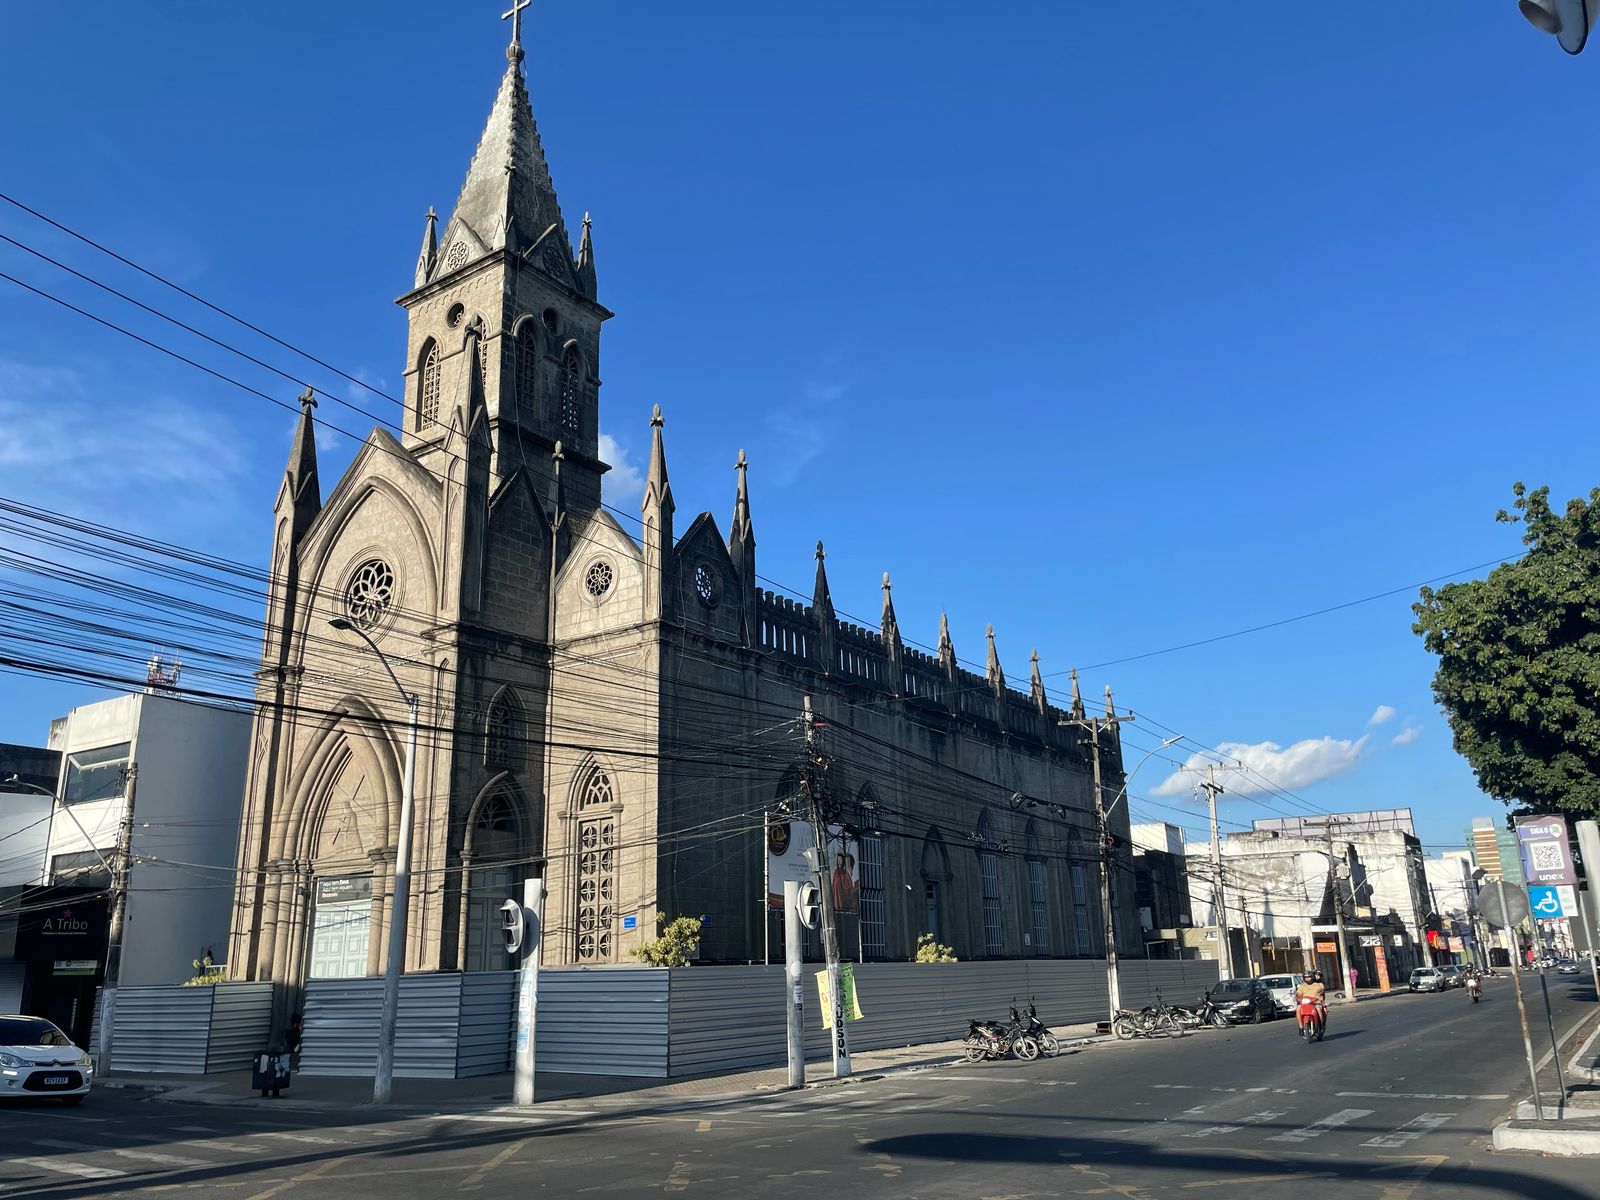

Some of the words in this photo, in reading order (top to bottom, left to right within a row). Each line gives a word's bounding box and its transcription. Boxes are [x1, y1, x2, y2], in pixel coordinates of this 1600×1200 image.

[1539, 873, 1565, 881] unex
[43, 918, 53, 930] A
[57, 917, 88, 930] Tribo
[1362, 938, 1381, 946] ZIG
